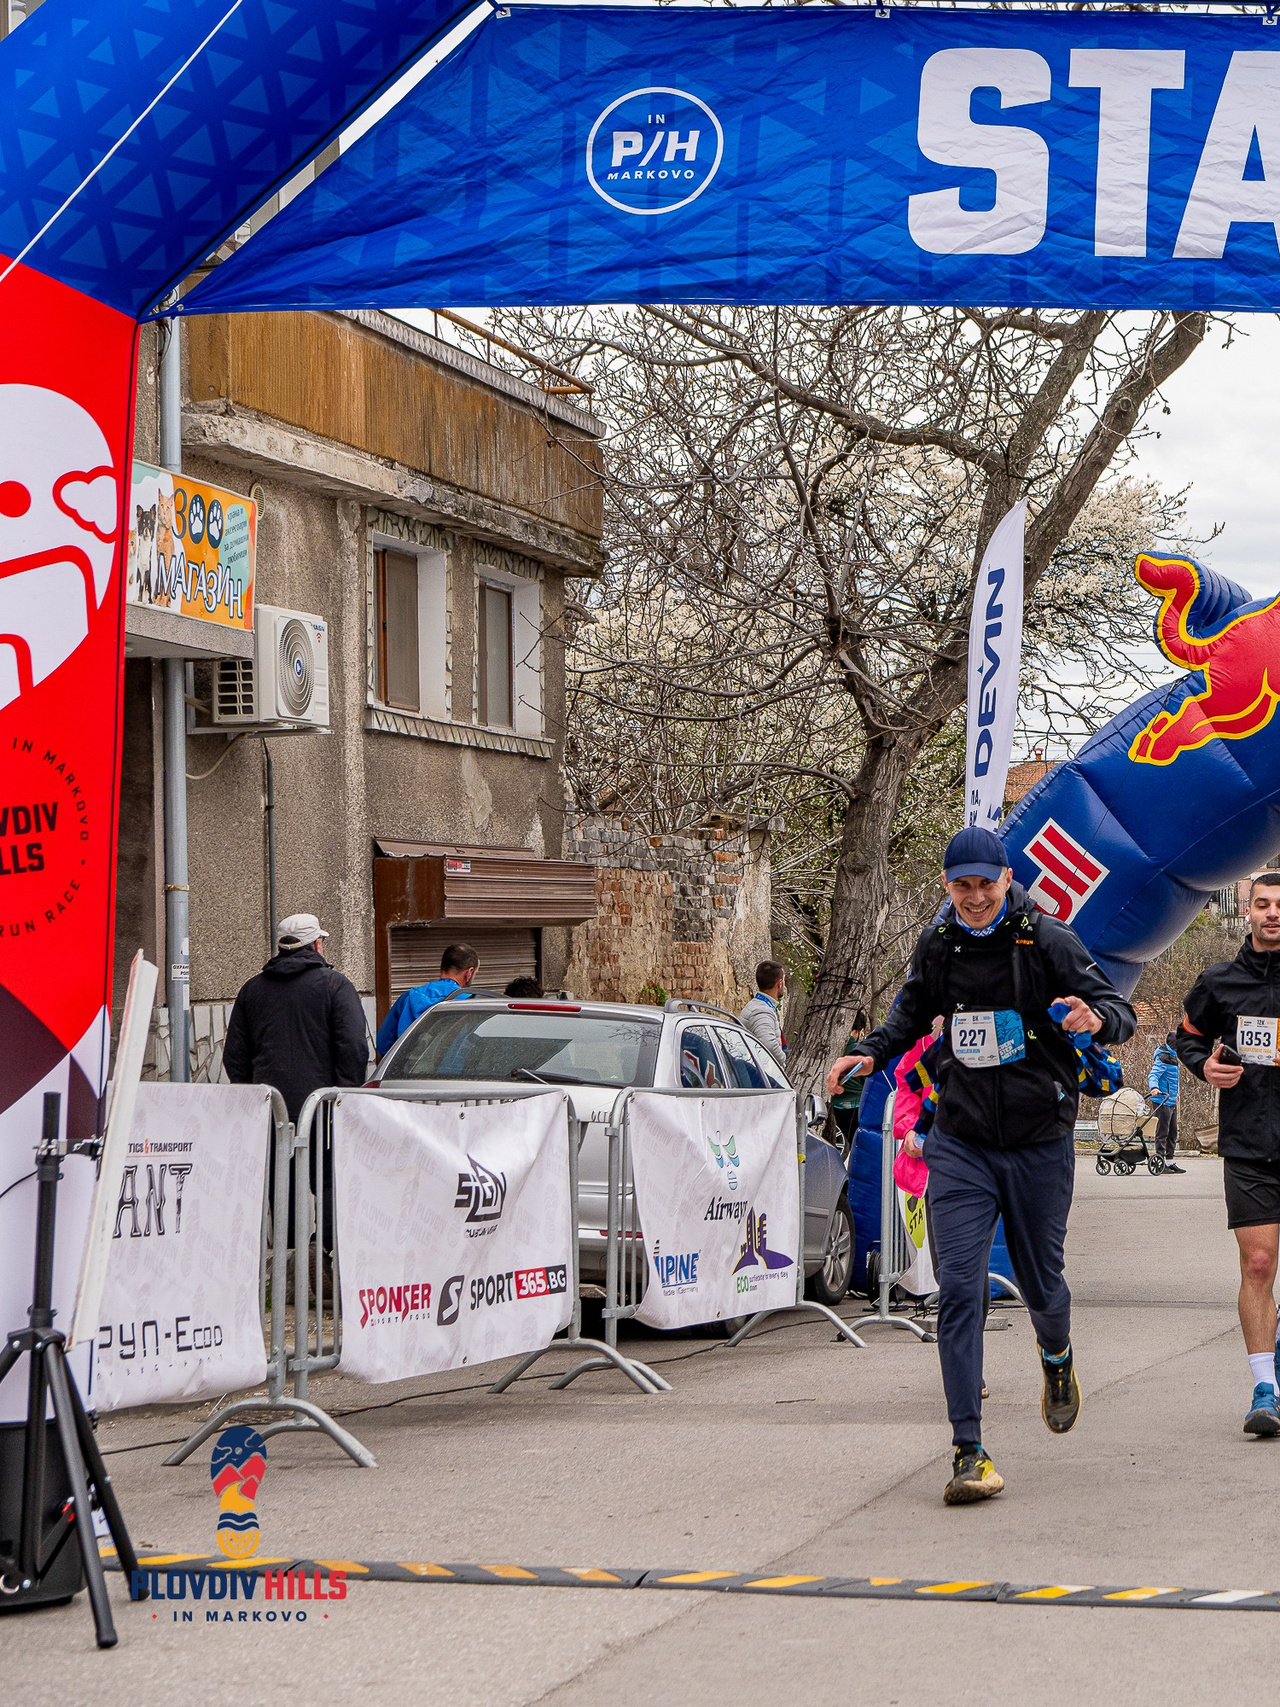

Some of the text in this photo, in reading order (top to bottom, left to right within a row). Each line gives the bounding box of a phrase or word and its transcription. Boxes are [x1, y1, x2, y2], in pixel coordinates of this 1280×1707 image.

[648, 114, 665, 124] IN
[611, 130, 700, 167] P/H
[607, 170, 695, 180] MARKOVO
[157, 552, 243, 619] МАГАЗИН
[974, 567, 1006, 778] DEVIN
[12, 737, 90, 841] IN MARKOVO
[44, 879, 81, 923] RACE
[958, 1028, 987, 1047] 227
[1240, 1030, 1272, 1047] 1353
[150, 1141, 194, 1153] TRANSPORT
[469, 1271, 514, 1311] SPORT
